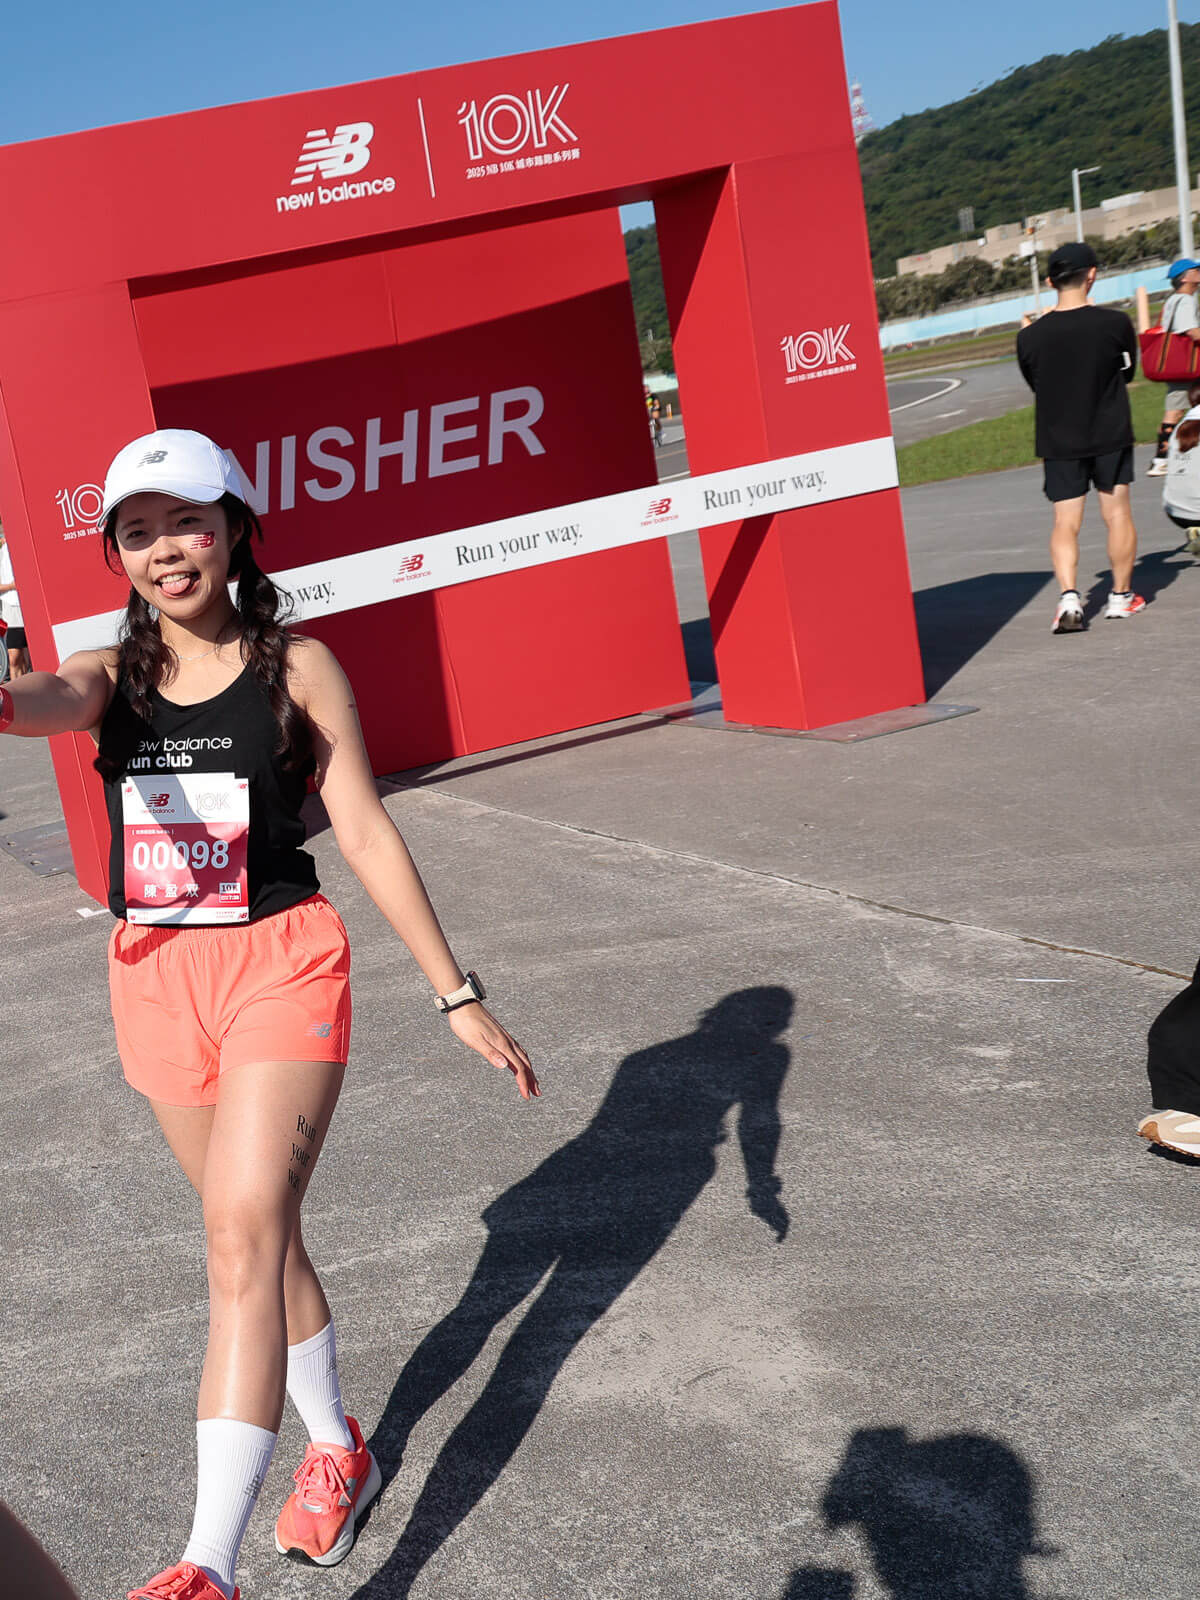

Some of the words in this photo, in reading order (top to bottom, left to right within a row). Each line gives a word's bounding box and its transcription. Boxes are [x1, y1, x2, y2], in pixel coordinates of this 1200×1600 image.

[457, 82, 578, 160] 10K
[466, 165, 485, 179] 2025
[275, 191, 317, 212] new
[318, 176, 396, 204] balance
[779, 323, 856, 373] 10K
[225, 385, 546, 516] NISHER
[54, 483, 104, 528] 10
[703, 488, 742, 511] Run
[746, 477, 787, 506] your
[790, 469, 828, 493] way.
[455, 544, 494, 567] Run
[498, 532, 541, 563] your
[545, 522, 584, 547] way.
[296, 581, 335, 605] way.
[137, 740, 160, 752] ew
[163, 737, 233, 752] balance
[155, 752, 193, 768] club
[133, 840, 229, 870] 00098
[296, 1114, 317, 1142] Run
